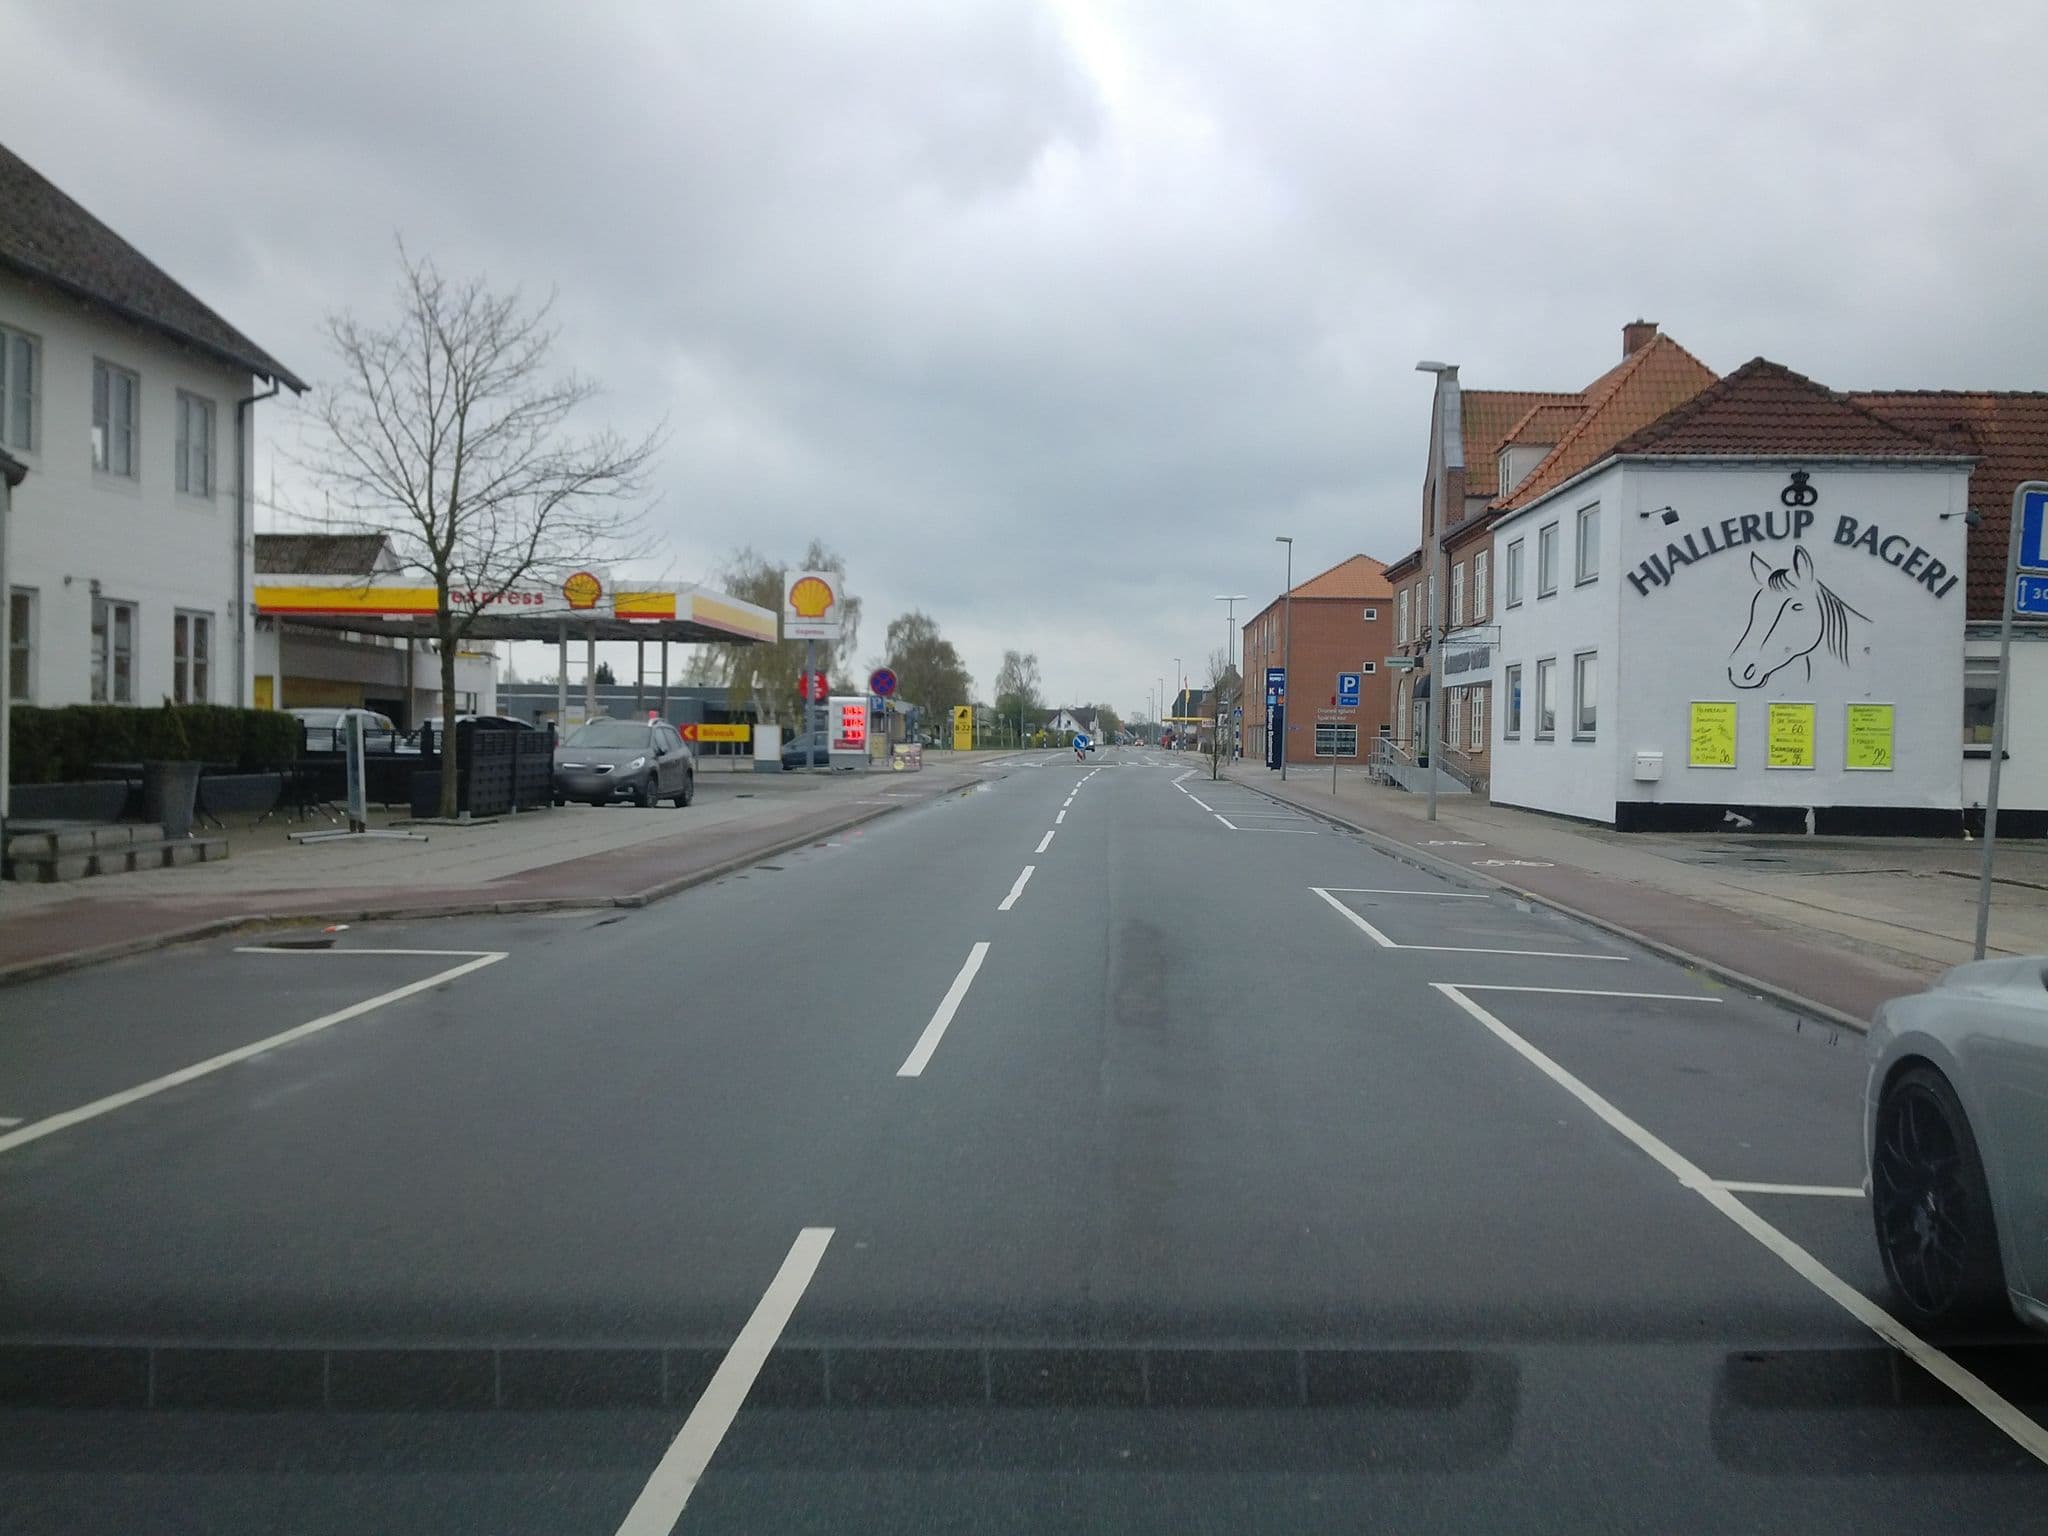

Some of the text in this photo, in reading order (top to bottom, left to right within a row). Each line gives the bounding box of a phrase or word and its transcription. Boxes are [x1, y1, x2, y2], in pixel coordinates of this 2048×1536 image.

[1626, 509, 1815, 598] HJALLERUP
[1833, 514, 1961, 600] BAGERI
[1343, 676, 1356, 693] P
